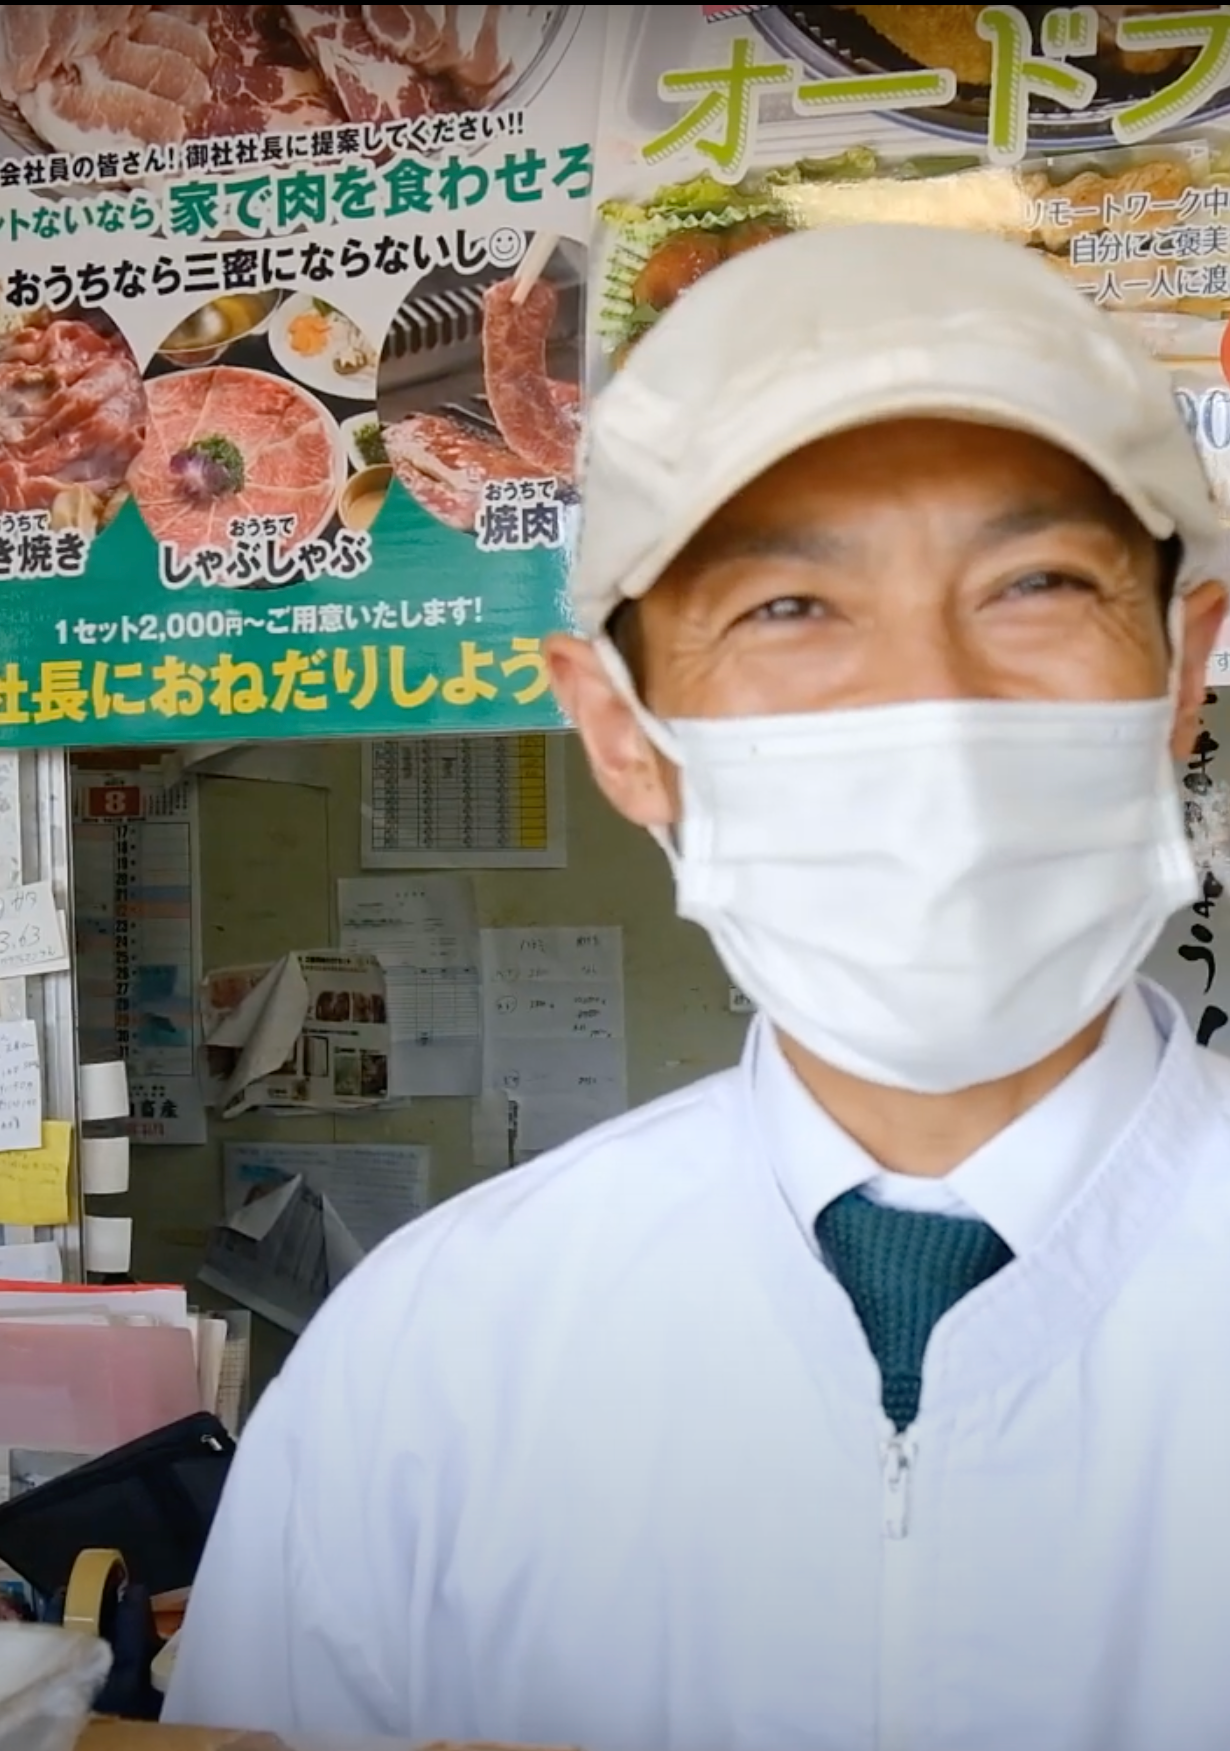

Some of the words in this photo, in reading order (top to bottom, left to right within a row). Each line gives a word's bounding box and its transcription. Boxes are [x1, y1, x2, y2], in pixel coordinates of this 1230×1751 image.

[0, 196, 154, 241] トないなら
[169, 143, 593, 236] 家で肉を食わせろ
[9, 230, 487, 307] おうちなら三密にならないし
[484, 480, 555, 501] おうちで
[0, 514, 48, 532] うちで
[230, 517, 295, 537] おうちで
[481, 503, 559, 545] 焼肉
[162, 536, 366, 584] しゃぶしゃぶ
[105, 791, 126, 814] 8
[115, 983, 128, 996] 27
[131, 1099, 178, 1119] 畜産
